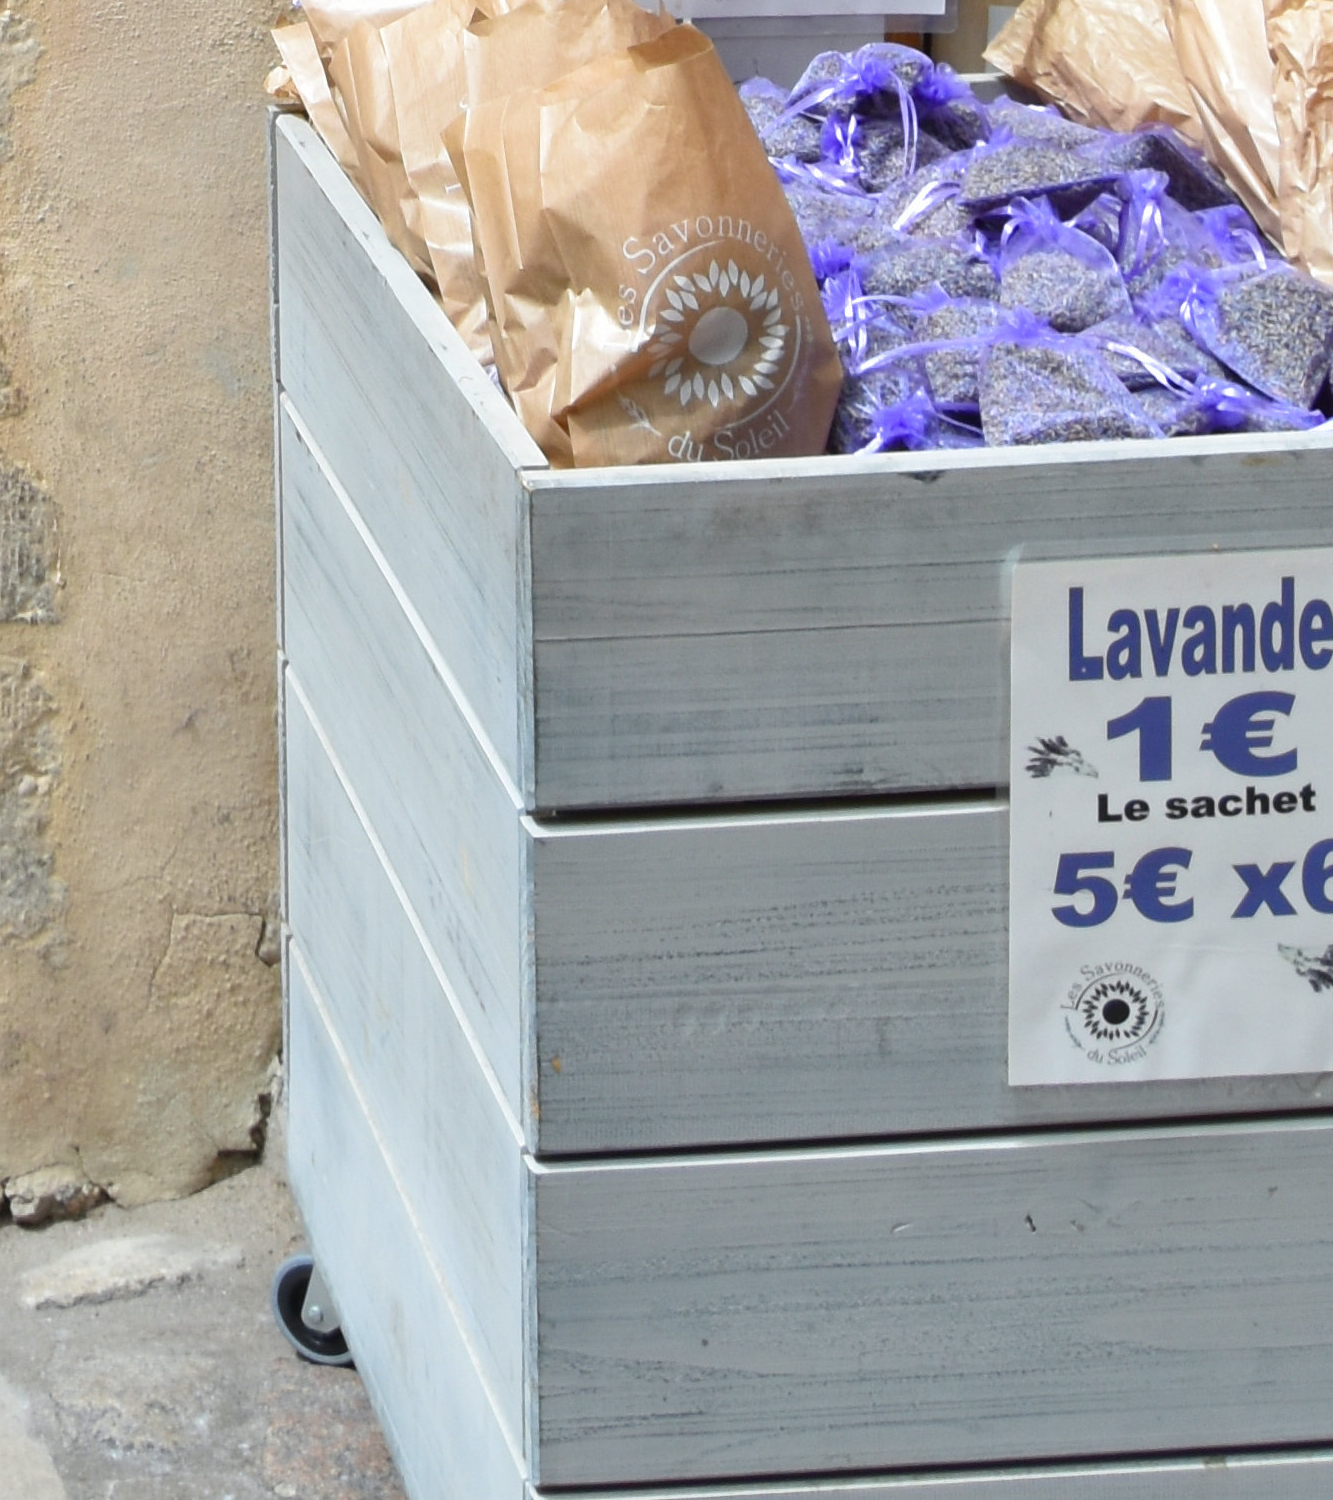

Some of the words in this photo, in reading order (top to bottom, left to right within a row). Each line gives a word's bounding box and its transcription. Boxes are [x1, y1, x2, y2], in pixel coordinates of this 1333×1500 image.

[622, 214, 805, 312] Savonneries
[667, 431, 703, 462] du
[712, 409, 791, 461] Soleil
[1068, 576, 1333, 682] Lavande
[1106, 690, 1298, 783] 1€
[1098, 792, 1150, 823] Le
[1165, 783, 1316, 820] sachet
[1050, 846, 1195, 928] 5€
[1060, 983, 1082, 1010] Les
[1080, 961, 1165, 1008] Savonneries
[1087, 1048, 1103, 1063] du
[1107, 1044, 1147, 1066] Soleil
